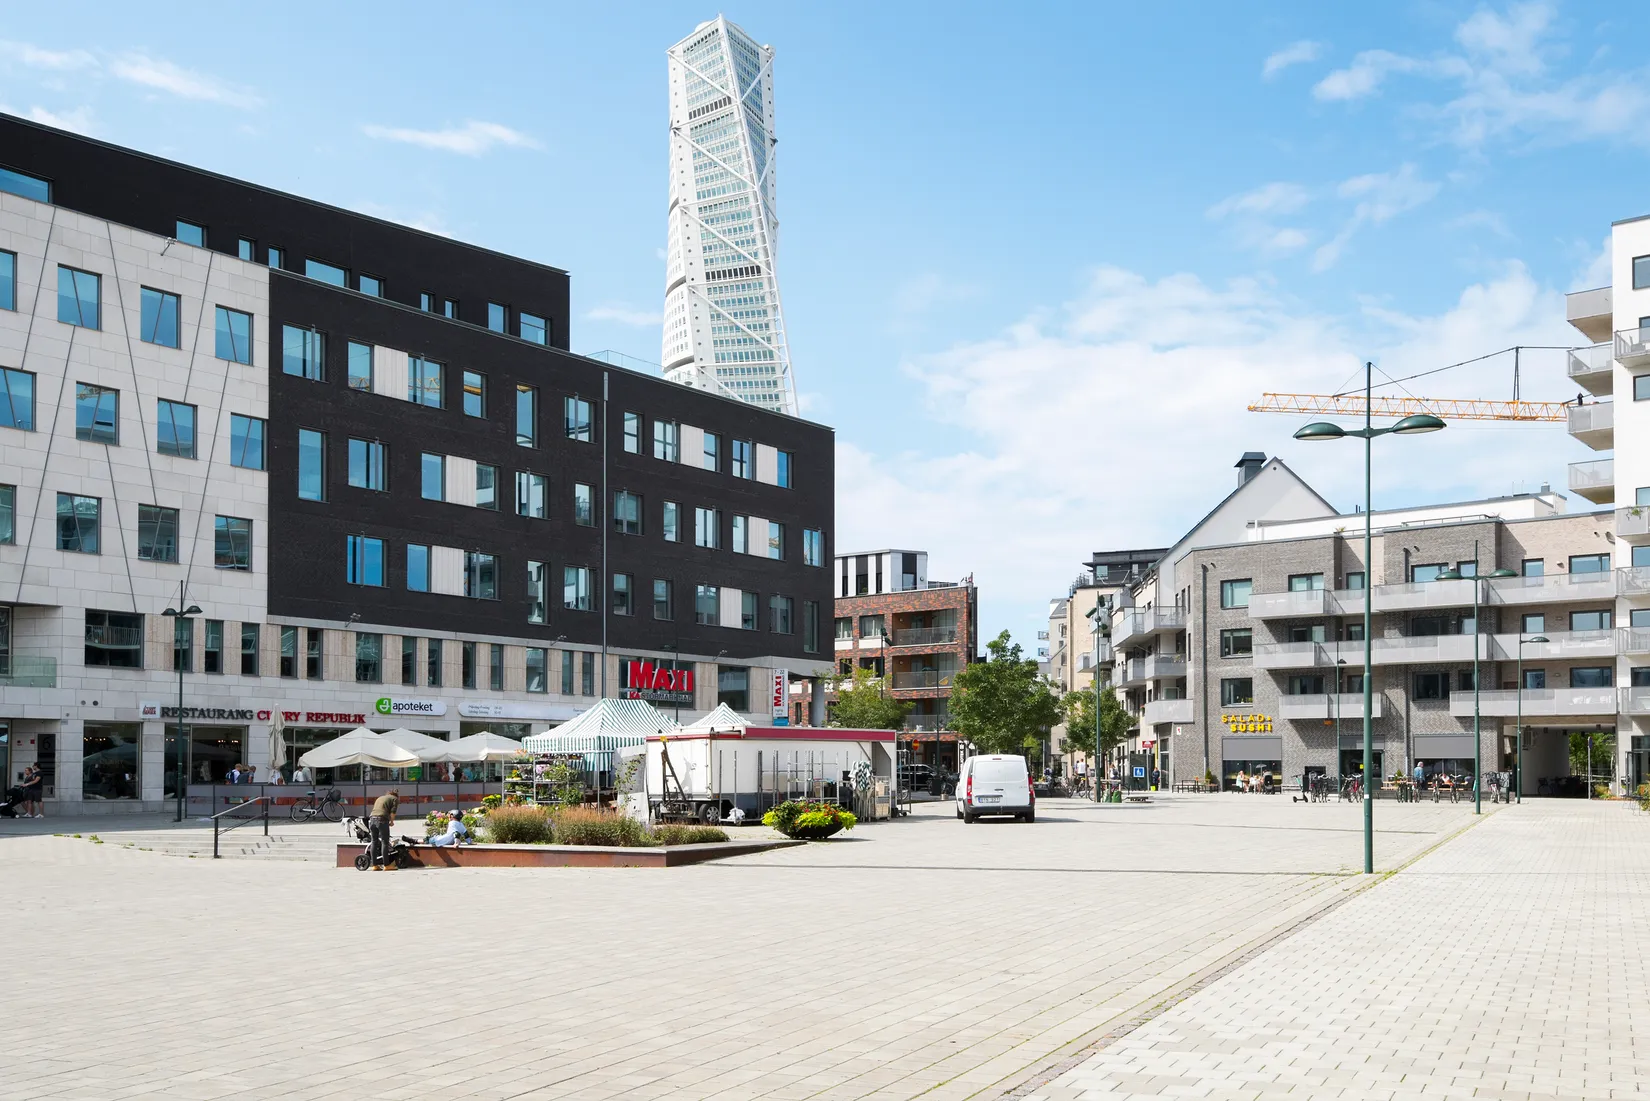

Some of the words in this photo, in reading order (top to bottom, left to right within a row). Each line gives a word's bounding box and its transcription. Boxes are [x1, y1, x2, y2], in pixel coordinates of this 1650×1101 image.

[628, 661, 693, 691] MAXI
[774, 676, 782, 706] MAXI
[392, 702, 433, 712] apoteket
[161, 706, 253, 720] RESTAURANG
[257, 710, 301, 721] CRY
[306, 712, 366, 724] REPUBLIK
[1221, 714, 1265, 723] SALAD
[1230, 723, 1273, 732] SUSHI
